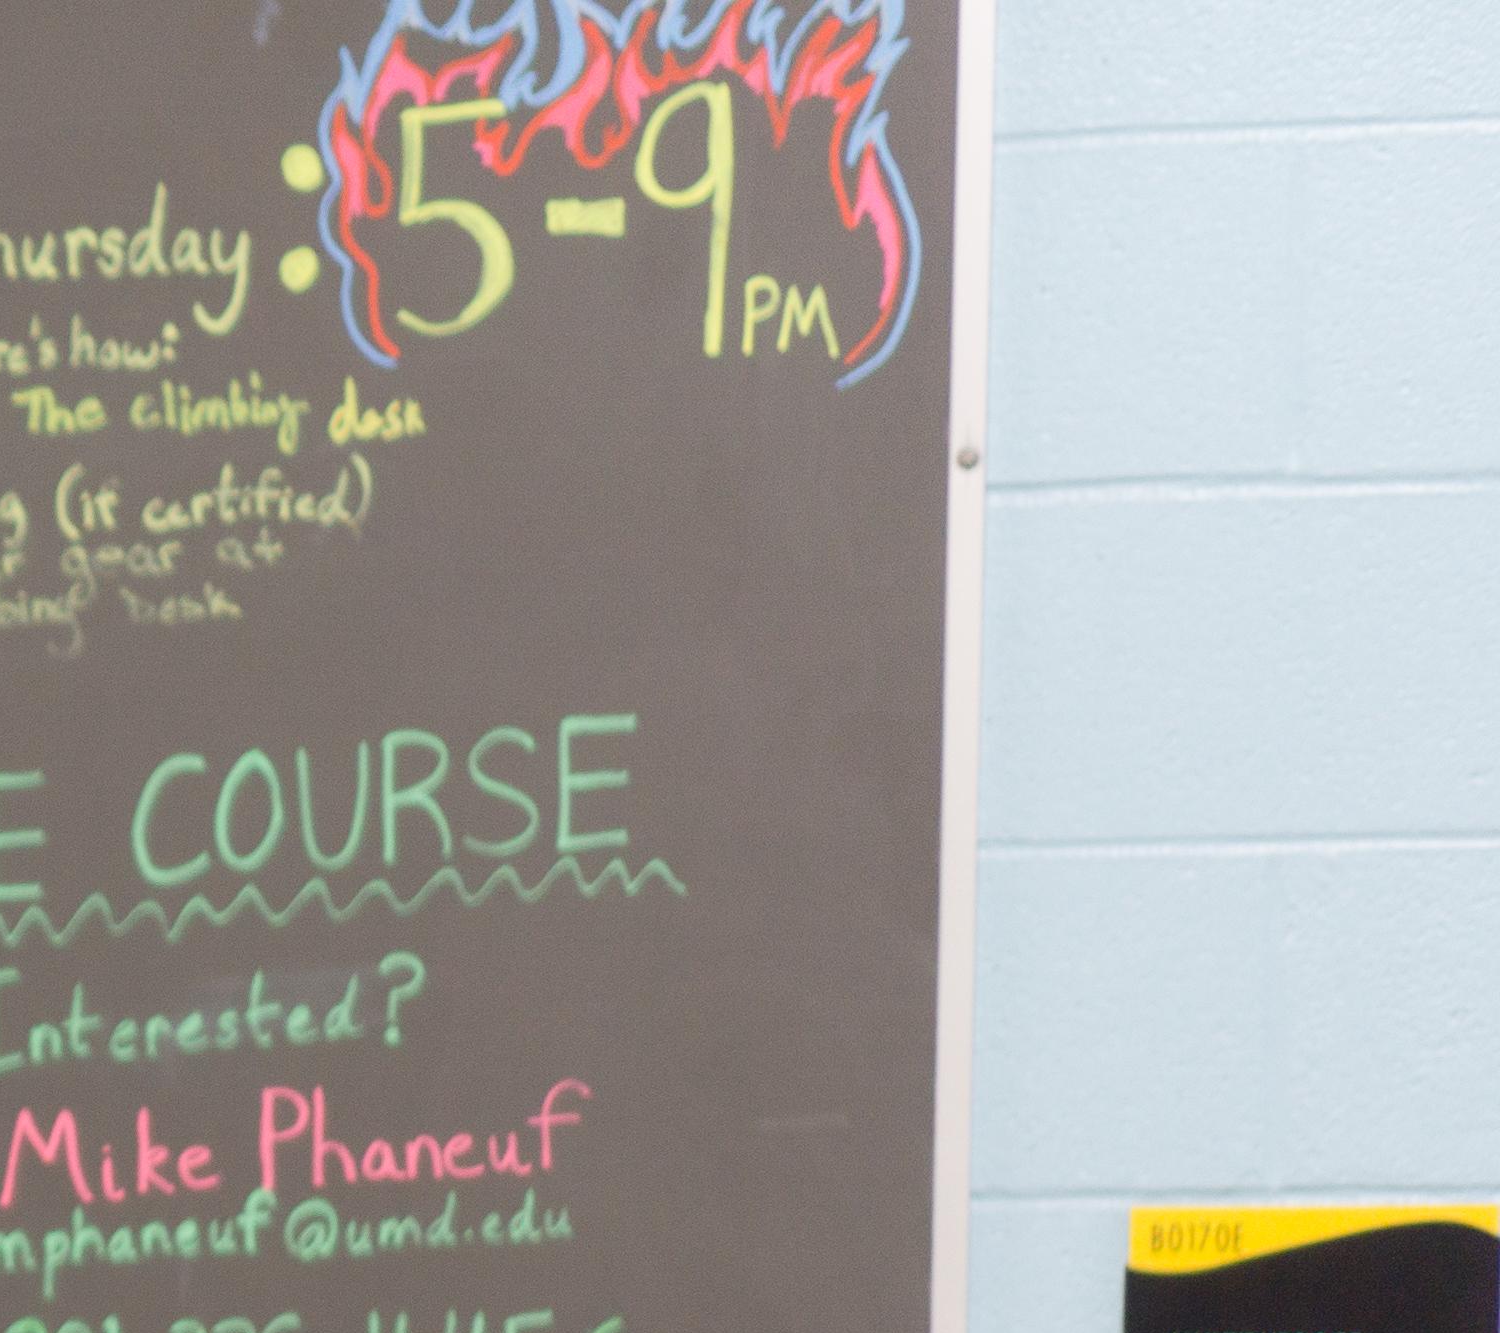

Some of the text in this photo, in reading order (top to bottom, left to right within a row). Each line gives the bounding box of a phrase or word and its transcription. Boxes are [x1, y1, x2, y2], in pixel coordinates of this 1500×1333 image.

[742, 274, 841, 360] PM
[12, 385, 108, 435] The
[129, 712, 640, 888] COURSE
[0, 1107, 223, 1209] Mike
[259, 1078, 593, 1195] Phaneuf
